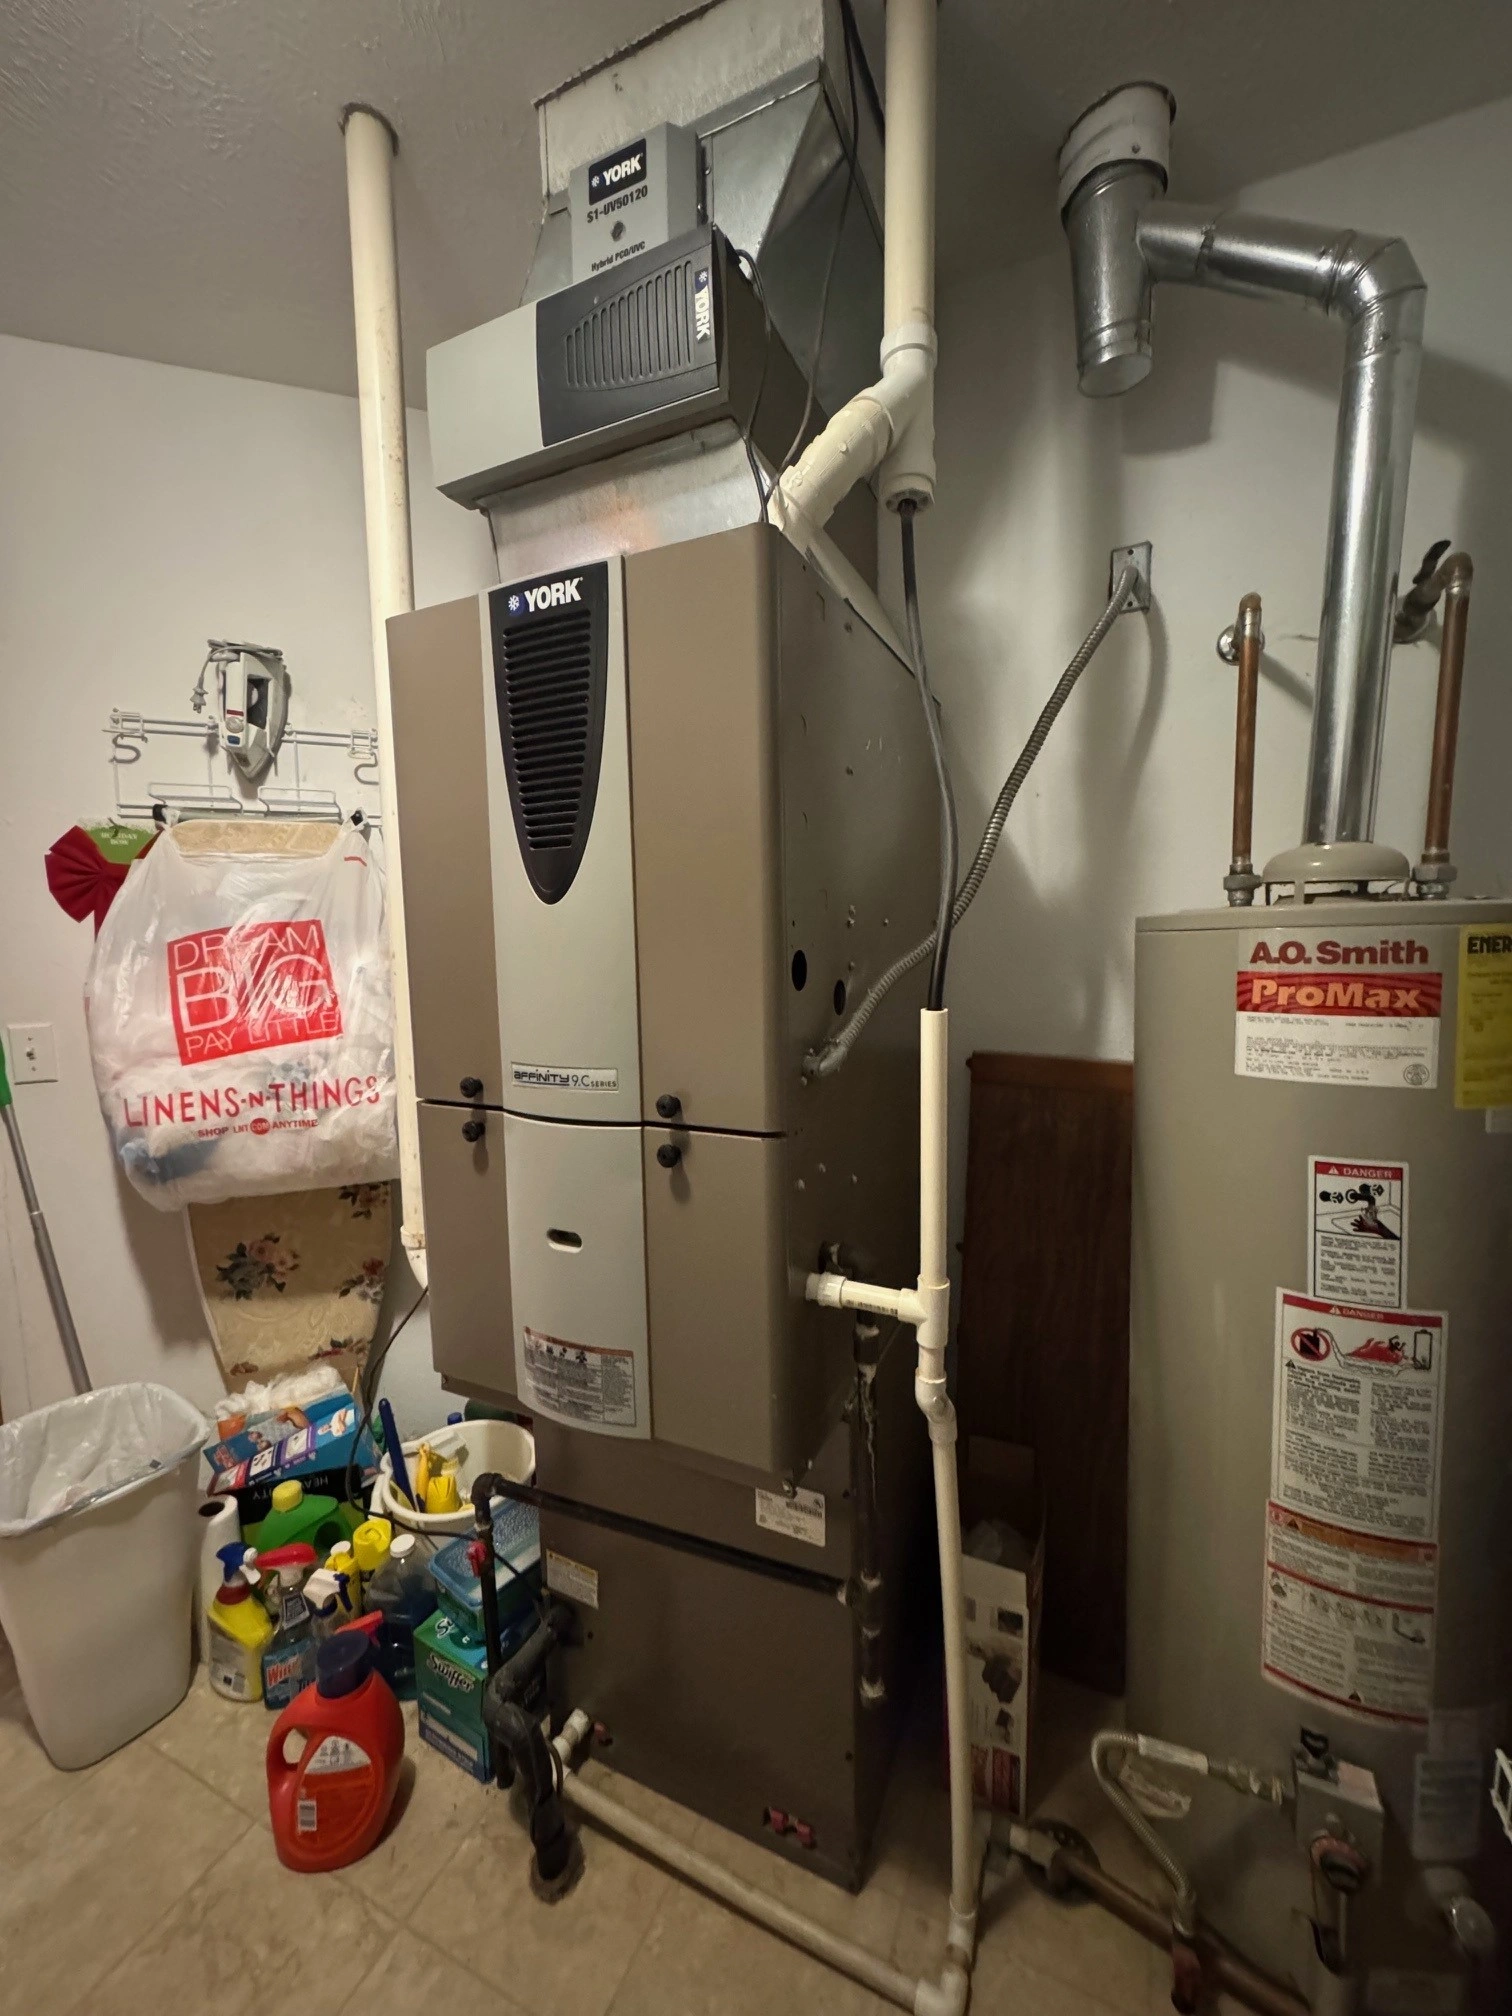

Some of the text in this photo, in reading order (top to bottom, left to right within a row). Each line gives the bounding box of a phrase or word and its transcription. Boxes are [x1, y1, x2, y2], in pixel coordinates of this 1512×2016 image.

[603, 154, 642, 186] YORK
[587, 185, 648, 223] S1-UV50120
[591, 254, 614, 271] Hybrid
[695, 285, 710, 340] YORK
[524, 577, 582, 612] YORK
[1250, 938, 1429, 965] A.O. Smith
[1252, 979, 1422, 1009] ProMax
[185, 1010, 339, 1059] PAY LITTLE
[590, 1080, 618, 1088] SERIES
[198, 1126, 229, 1138] SHOP
[272, 1118, 318, 1130] ANYTIME
[1342, 1166, 1393, 1180] DANGER
[426, 1652, 475, 1694] Swiffer
